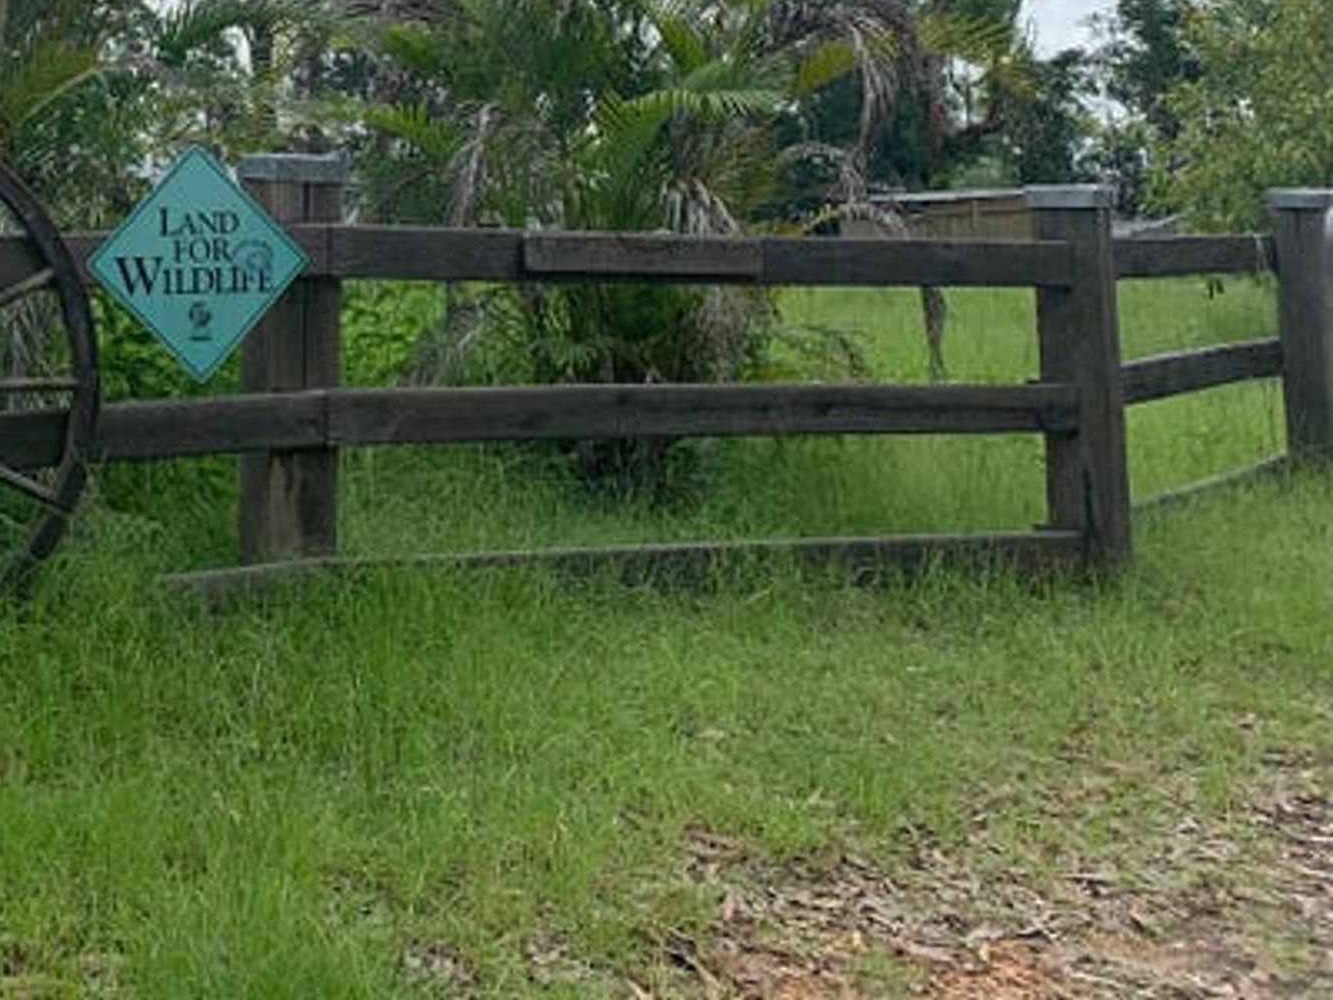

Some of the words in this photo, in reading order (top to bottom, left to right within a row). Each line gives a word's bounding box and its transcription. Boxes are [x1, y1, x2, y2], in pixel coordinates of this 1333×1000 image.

[159, 206, 241, 236] LAND
[173, 236, 234, 264] FOR
[115, 256, 271, 297] WILDLIFE
